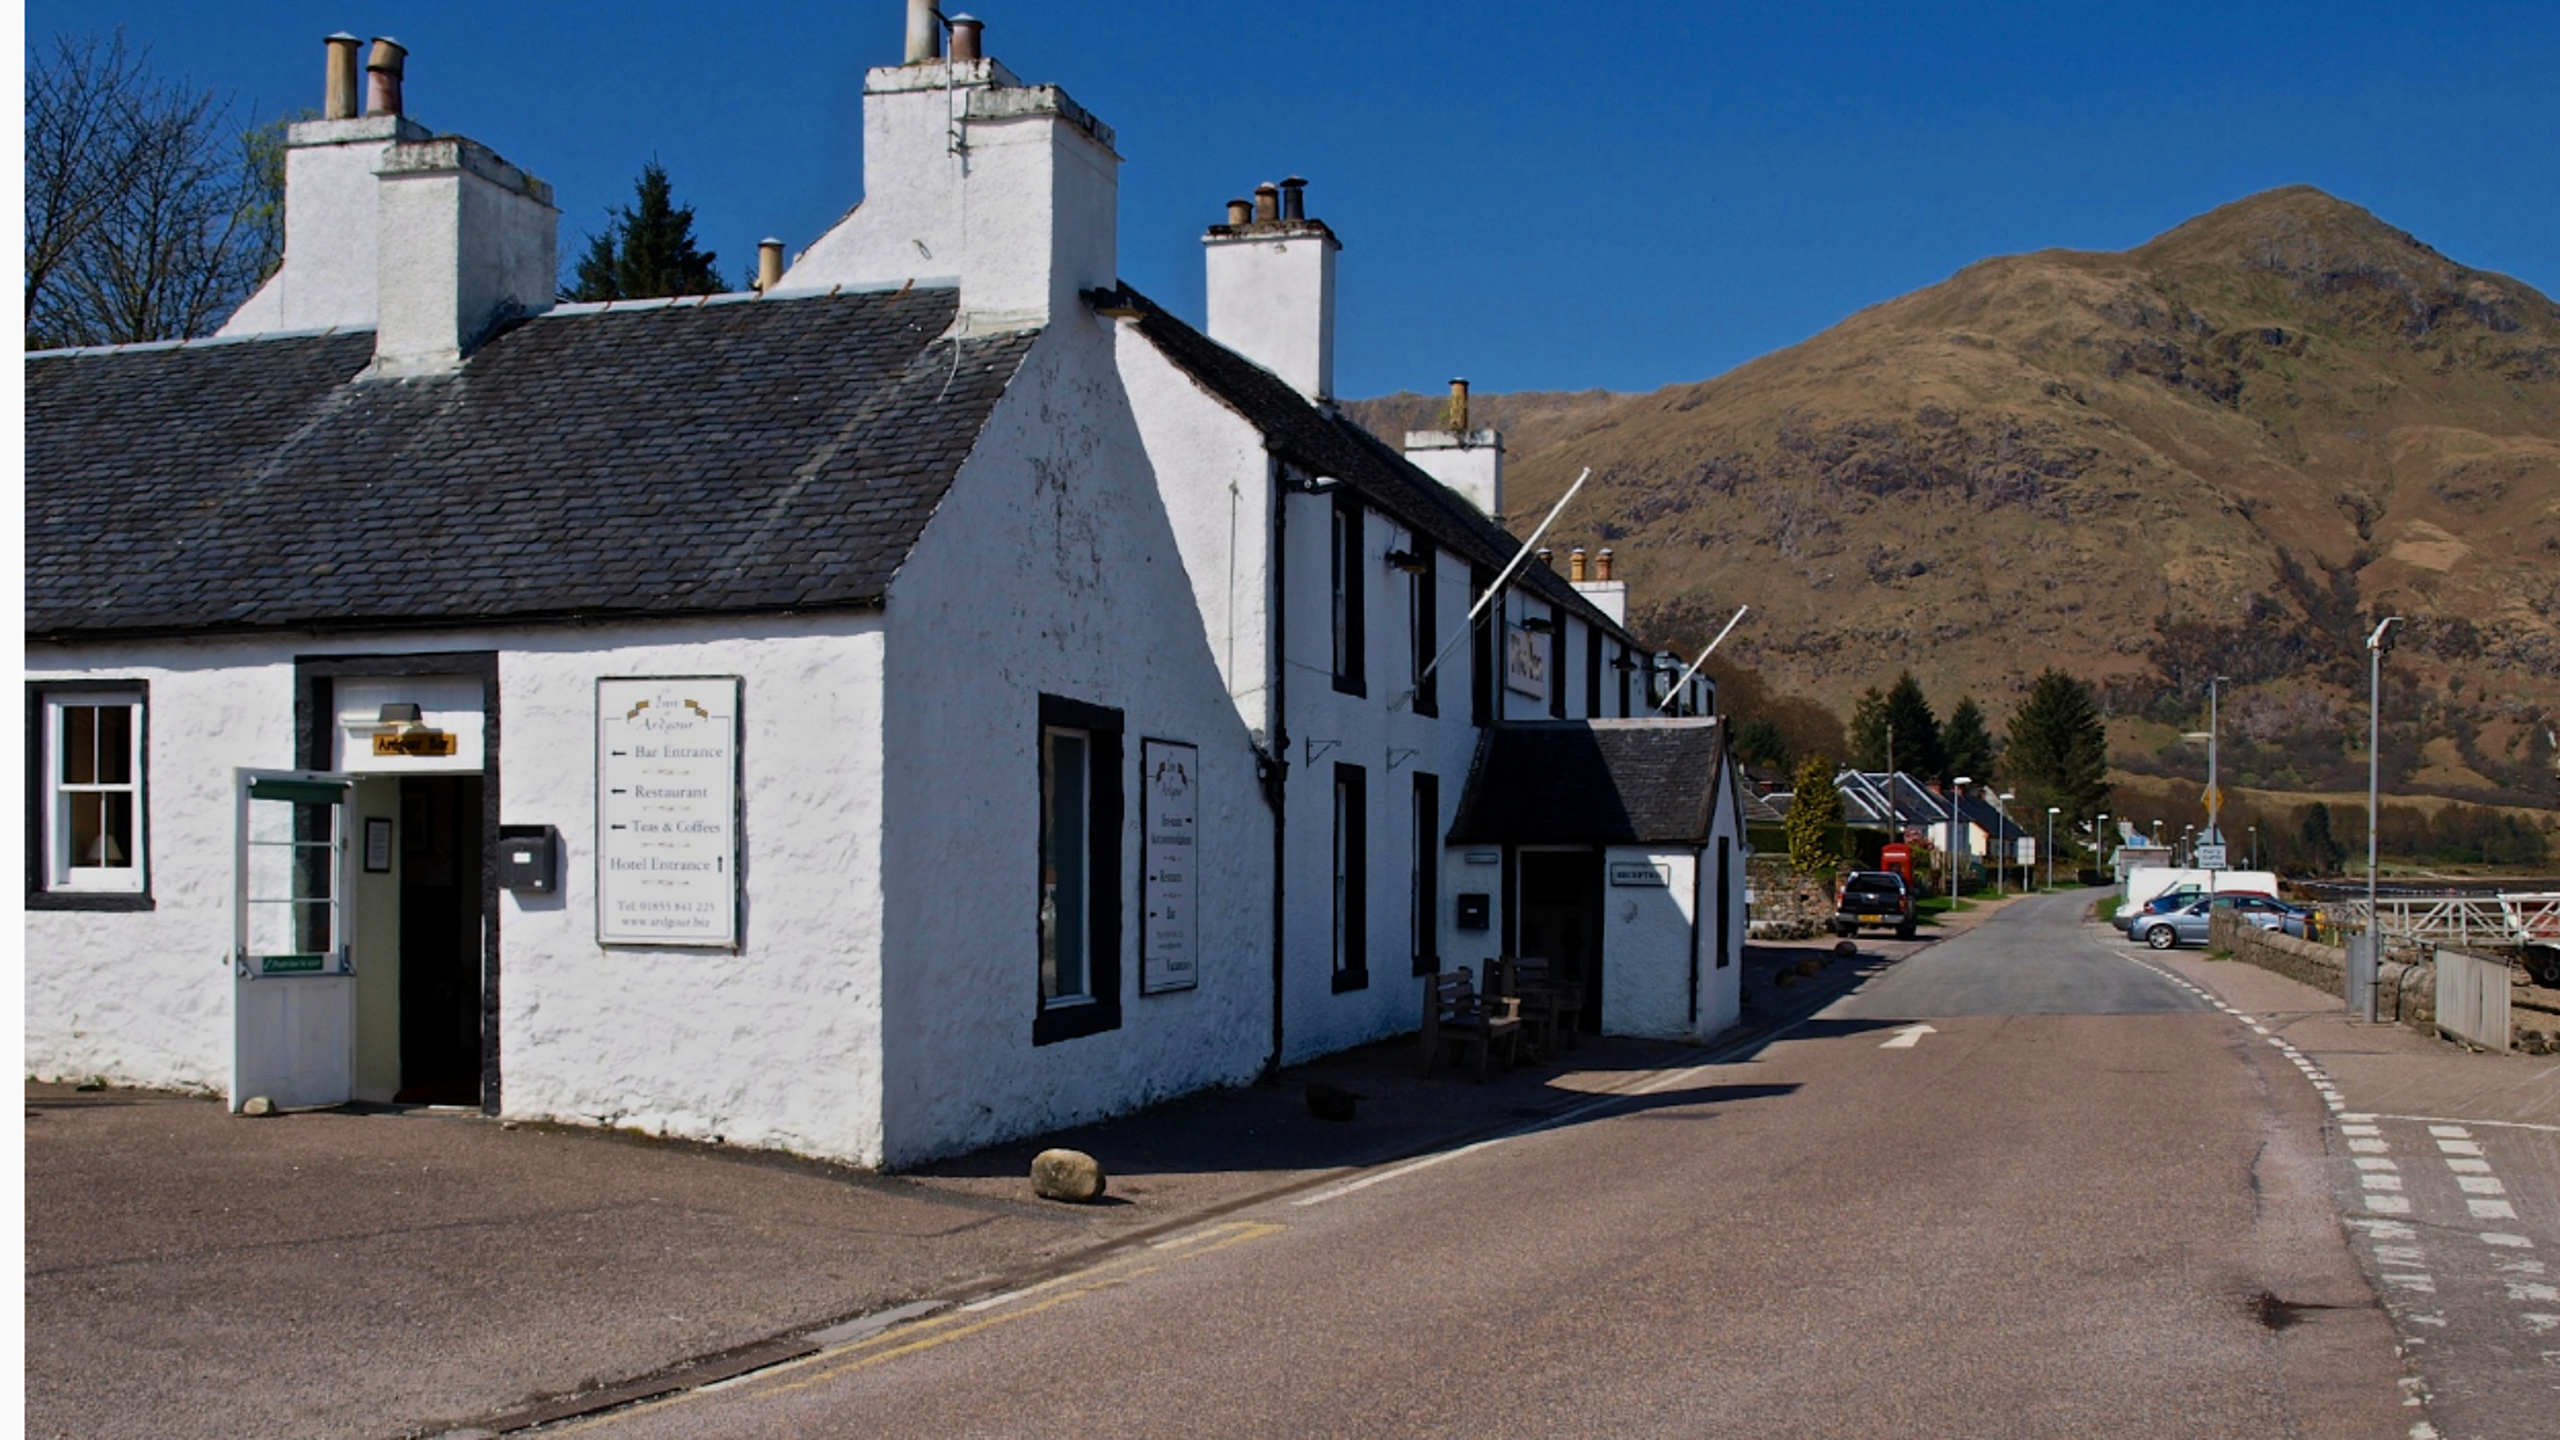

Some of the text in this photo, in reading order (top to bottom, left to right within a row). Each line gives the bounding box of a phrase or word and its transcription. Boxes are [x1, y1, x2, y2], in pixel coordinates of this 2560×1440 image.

[636, 717, 694, 734] Ardgour
[635, 746, 723, 758] Bar Entrance
[635, 785, 708, 798] Restaurant
[632, 820, 721, 833] Teas & Coffees
[610, 857, 711, 871] Hotel Entrance
[640, 901, 672, 912] 01855
[675, 901, 692, 912] 841
[696, 901, 715, 912] 225
